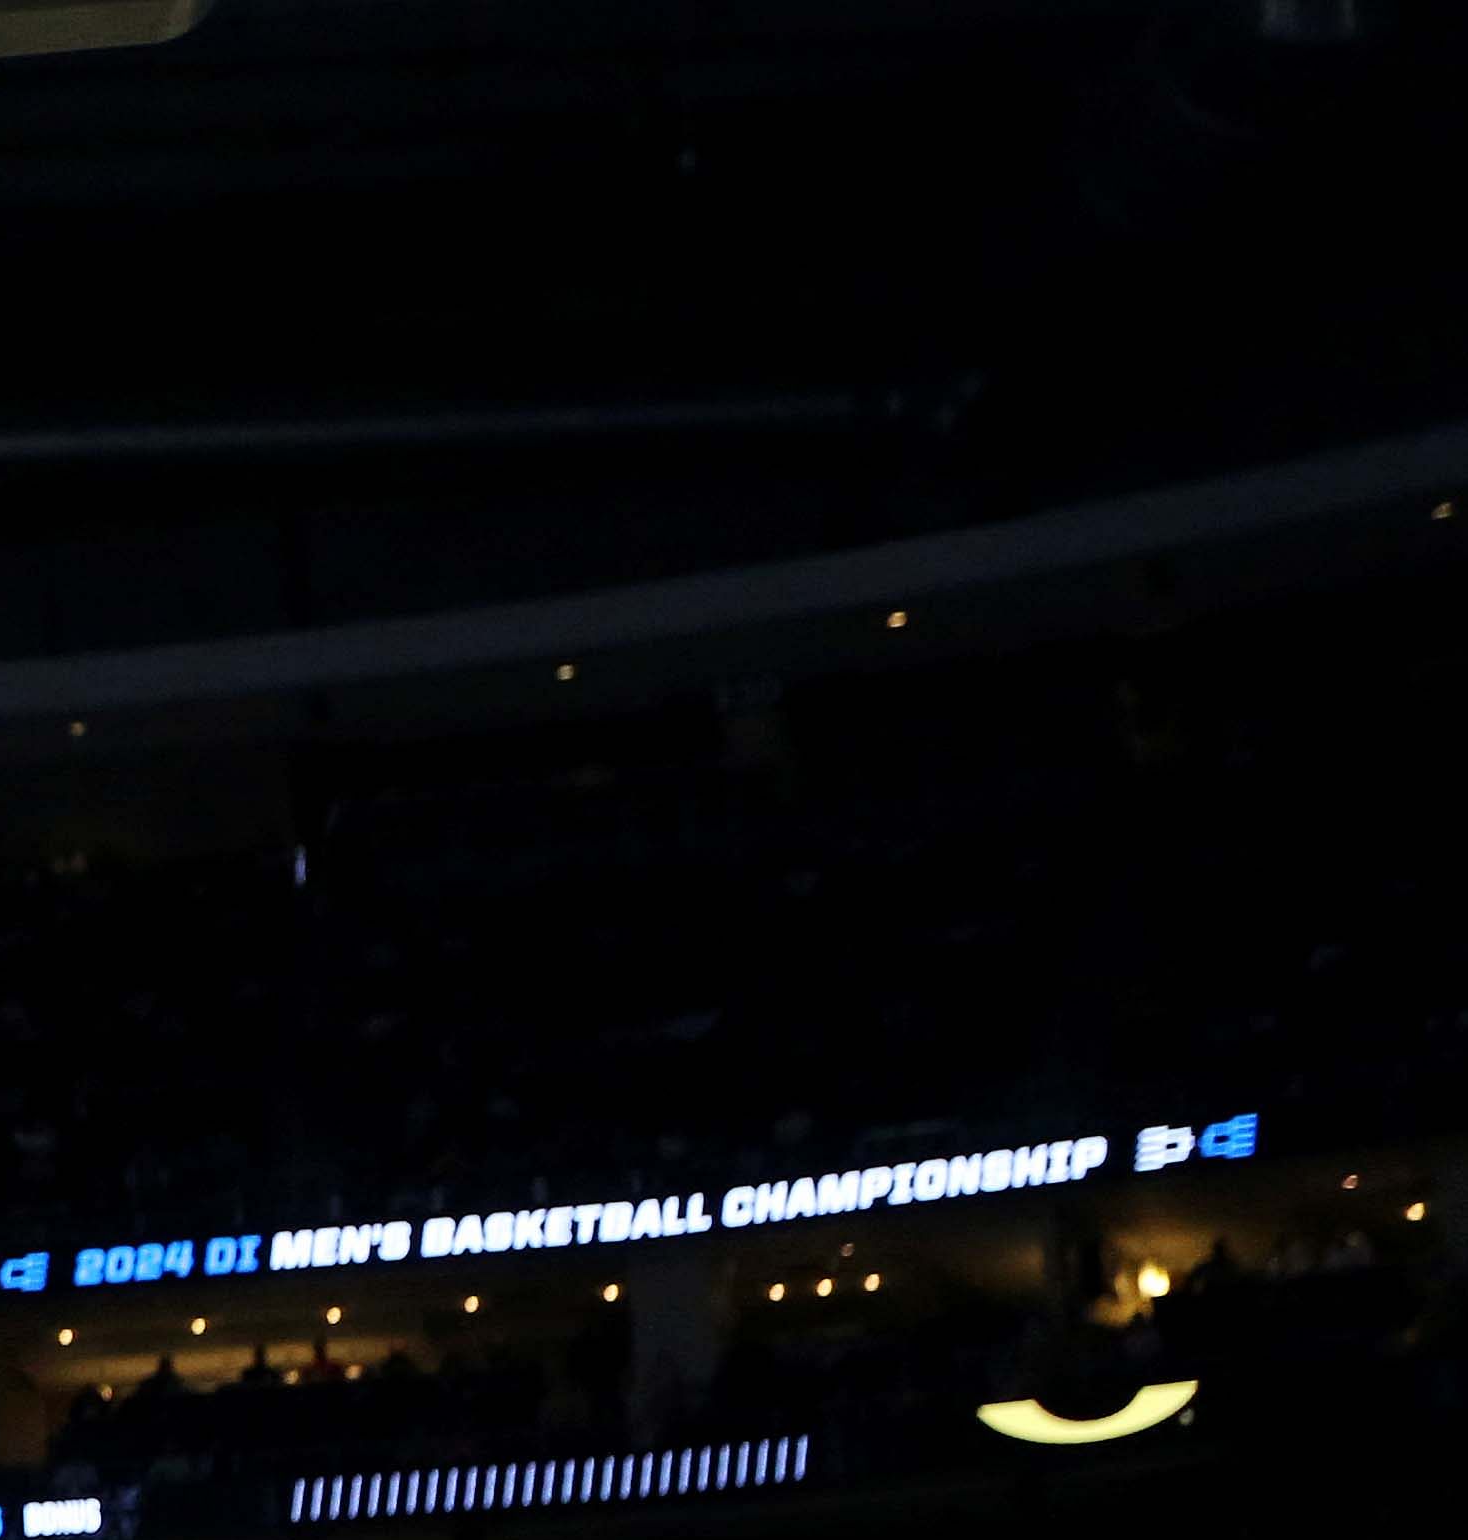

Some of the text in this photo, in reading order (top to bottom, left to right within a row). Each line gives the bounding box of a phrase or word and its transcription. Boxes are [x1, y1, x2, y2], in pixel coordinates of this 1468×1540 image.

[74, 1135, 1108, 1286] 2024 DI MEN'S BASKETBALL CHAMPIONSHIP
[23, 1498, 102, 1538] BONUS
